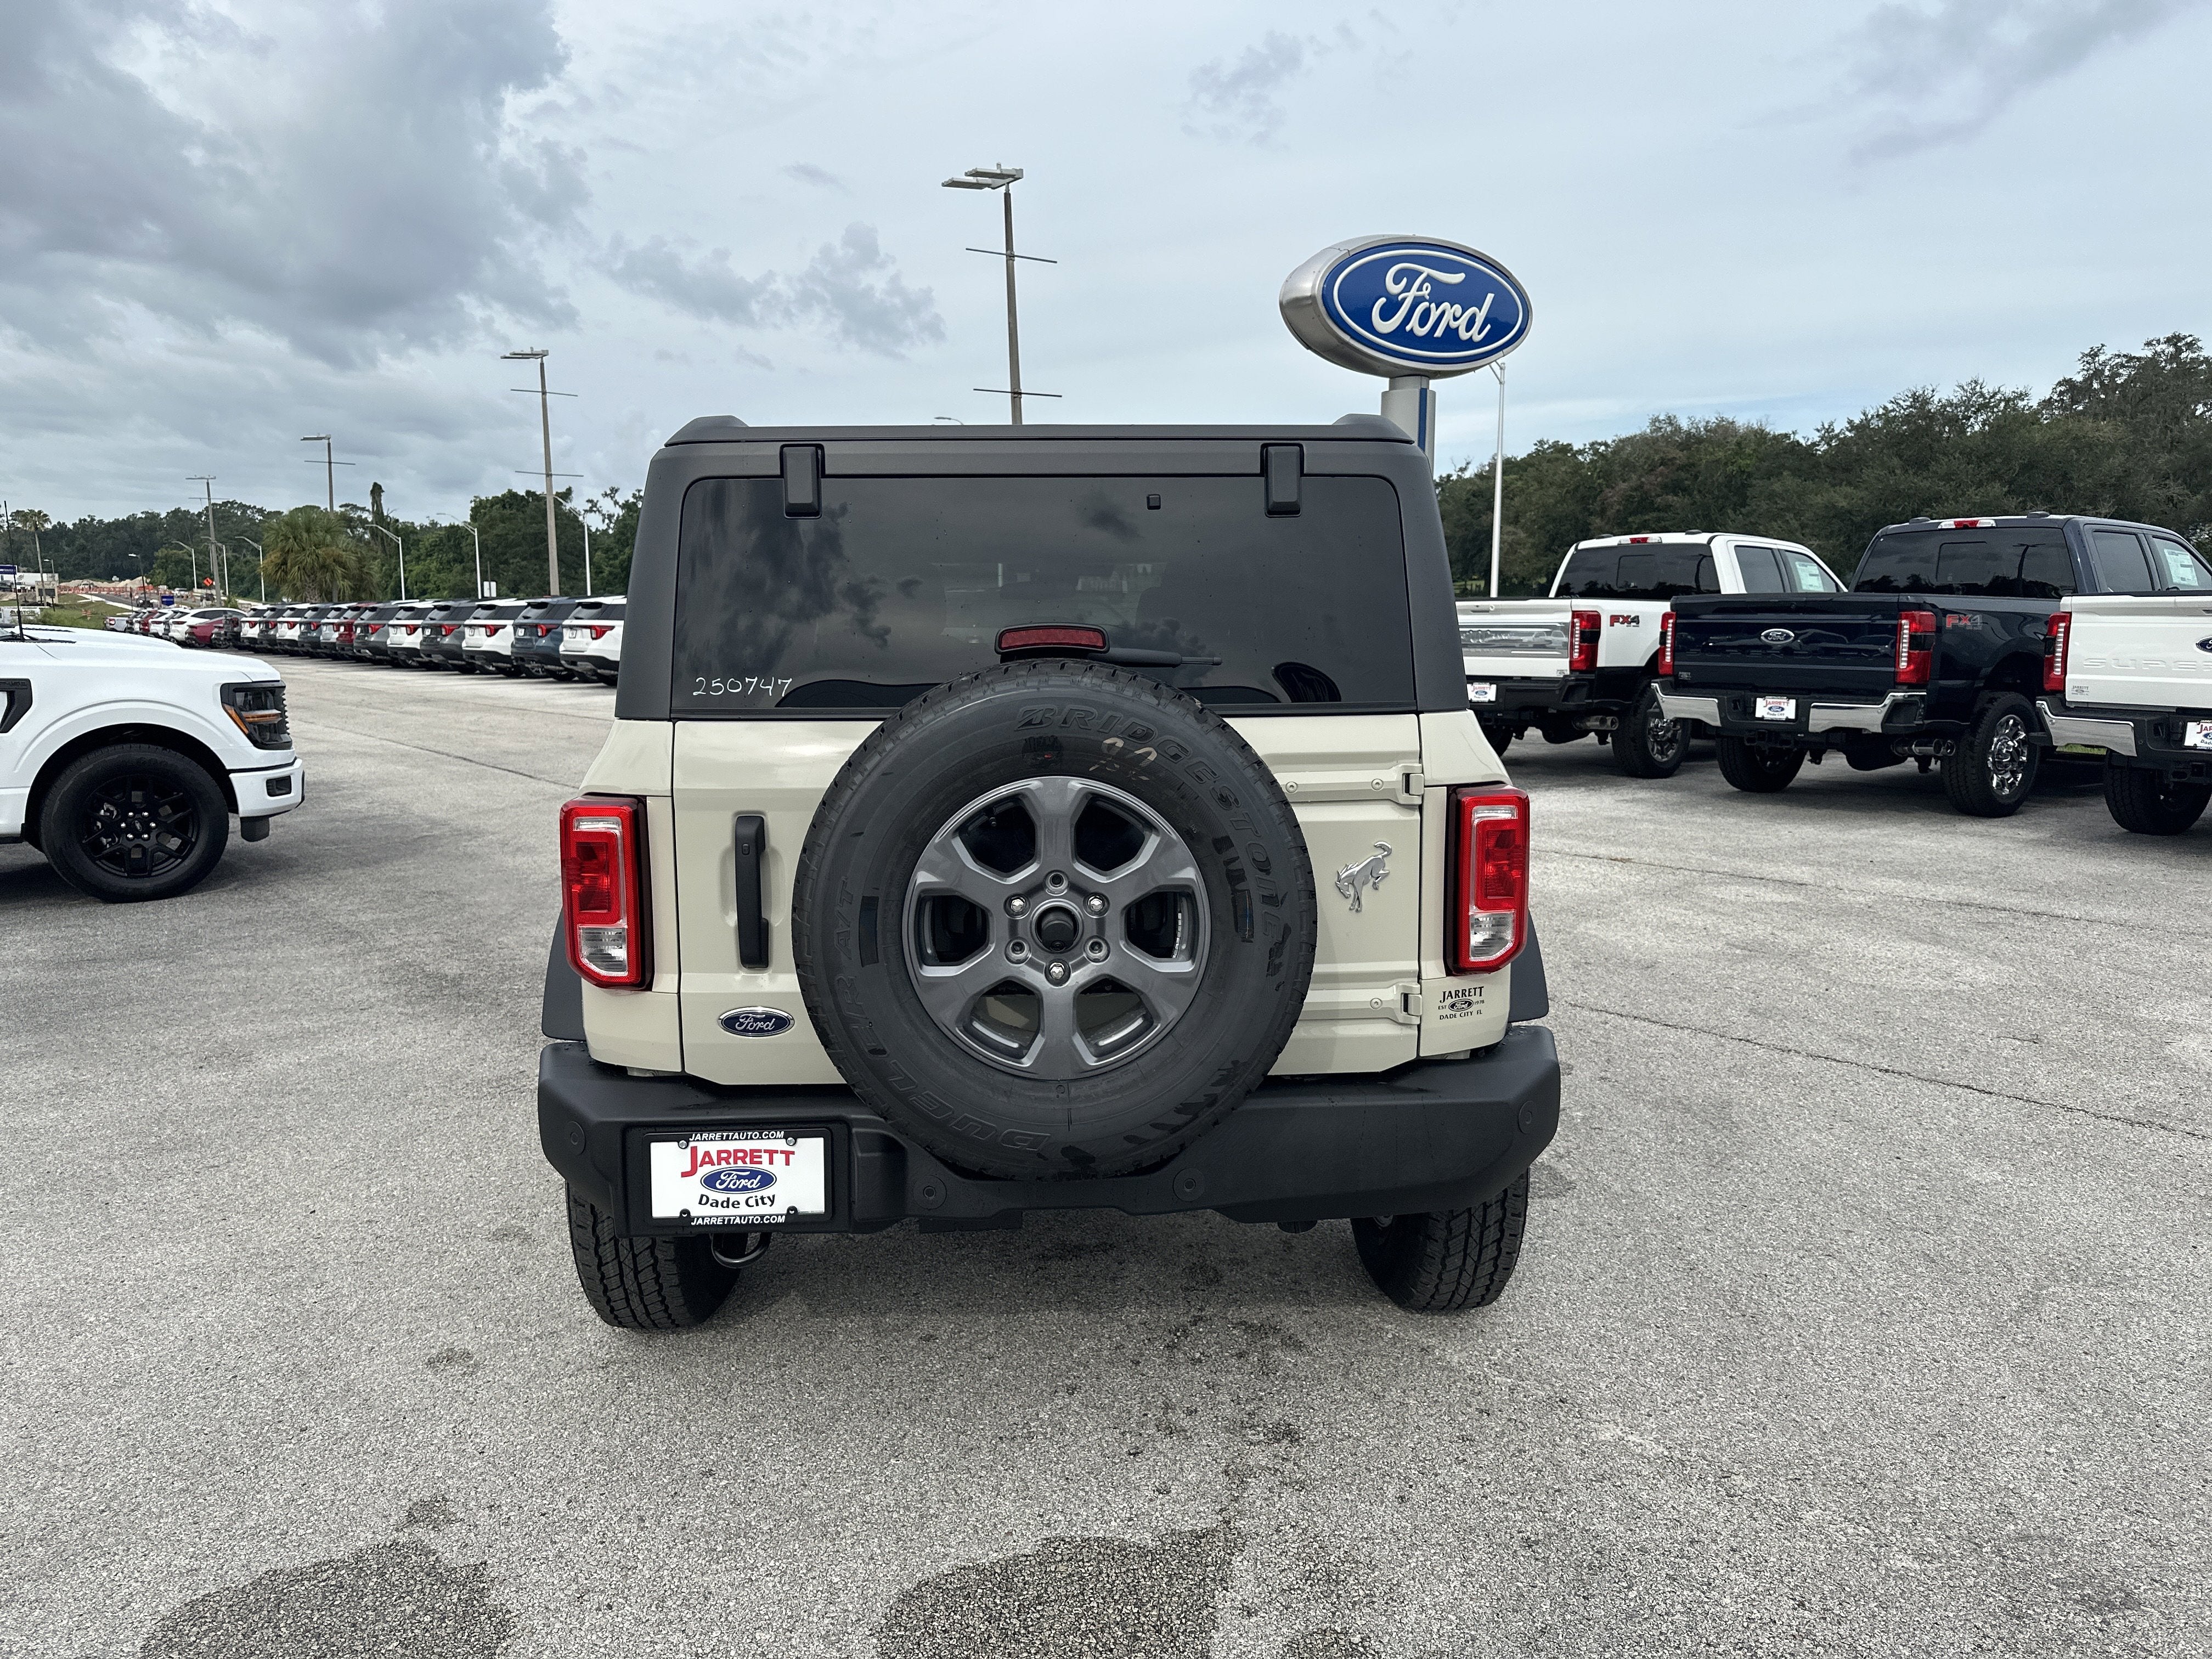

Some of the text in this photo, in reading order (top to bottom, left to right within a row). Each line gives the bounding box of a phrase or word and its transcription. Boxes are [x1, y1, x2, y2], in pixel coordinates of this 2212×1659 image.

[1372, 262, 1495, 343] Ford
[1610, 614, 1640, 627] FX4
[1946, 614, 1982, 629] FX4
[1768, 631, 1786, 640] Ford
[692, 676, 793, 697] 250747
[1014, 705, 1282, 941] BRIDGESTONE
[1439, 986, 1485, 1003] JARRETT
[735, 1014, 776, 1031] Ford
[833, 877, 1051, 1151] DUELER A/T
[689, 1131, 785, 1142] JARRETTAUTO.COM
[680, 1145, 795, 1178] JARRETT
[715, 1170, 761, 1189] Ford
[698, 1193, 777, 1209] Dade City
[691, 1215, 786, 1226] JARRETTAUTO.COM
